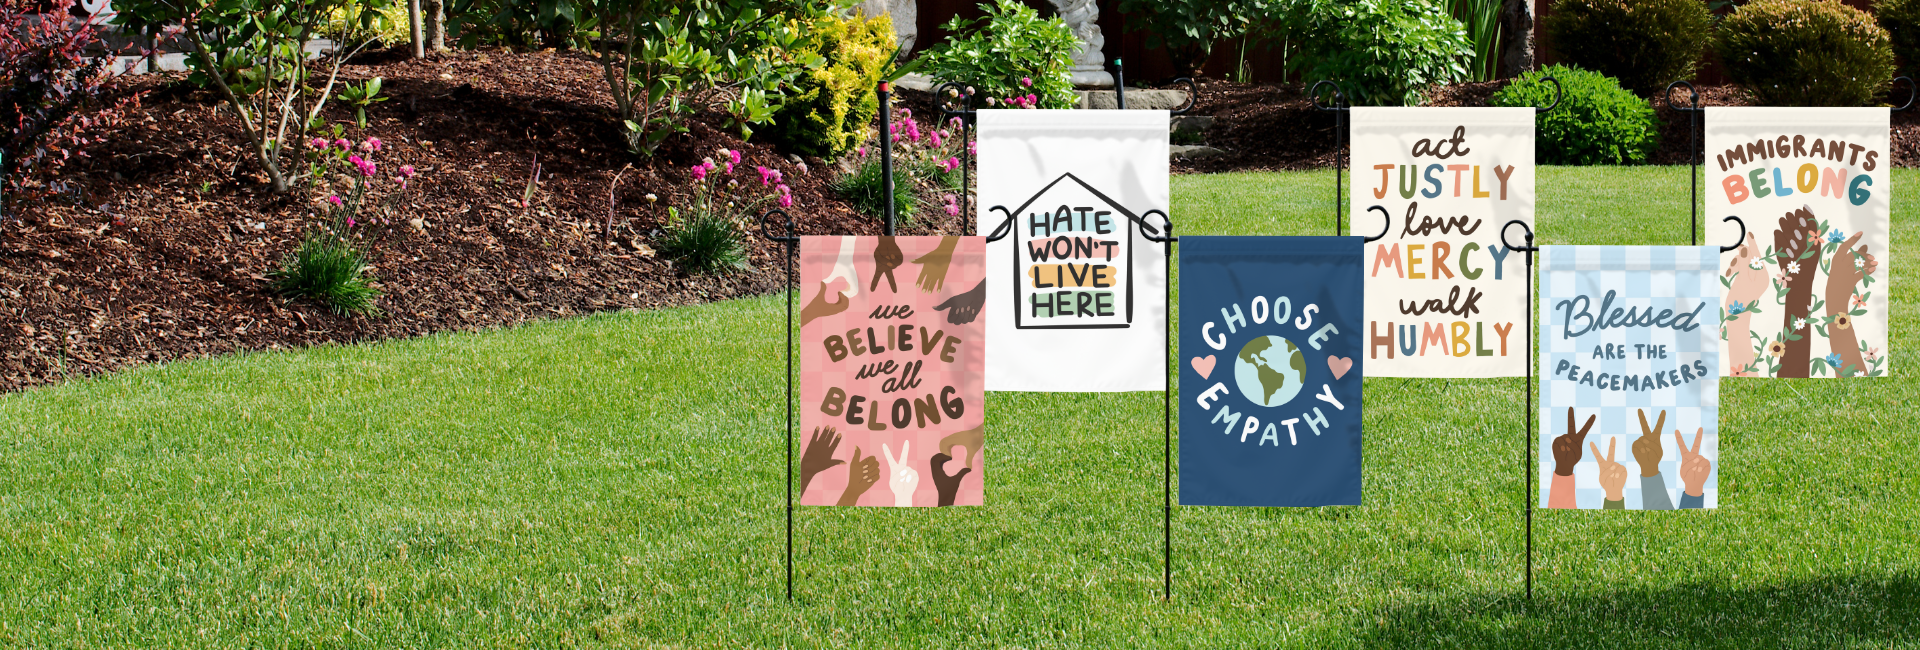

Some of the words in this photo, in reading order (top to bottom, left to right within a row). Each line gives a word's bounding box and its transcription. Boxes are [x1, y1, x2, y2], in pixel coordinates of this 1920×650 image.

[1412, 125, 1470, 160] act
[1716, 134, 1879, 172] IMMIGRANTS
[1373, 163, 1515, 200] JUSTLY
[1722, 163, 1873, 206] BELONG
[1030, 205, 1112, 237] HATE
[1400, 201, 1482, 240] love
[1027, 235, 1119, 262] WON'T
[1371, 241, 1511, 280] MERCY
[1034, 262, 1110, 289] LIVE
[869, 304, 914, 319] we
[1032, 291, 1115, 318] HERE
[1399, 285, 1483, 319] walk
[1555, 289, 1706, 340] Blessed
[1201, 295, 1340, 351] CHOOSE
[1370, 320, 1514, 360] HUMBLY
[823, 324, 962, 363] BELIEVE
[1592, 343, 1626, 360] ARE
[1634, 343, 1668, 360] THE
[855, 359, 899, 380] we
[881, 360, 923, 394] all
[1555, 359, 1708, 392] PEACEMAKERS
[820, 385, 965, 431] BELONG
[1196, 382, 1345, 447] EMPATHY
